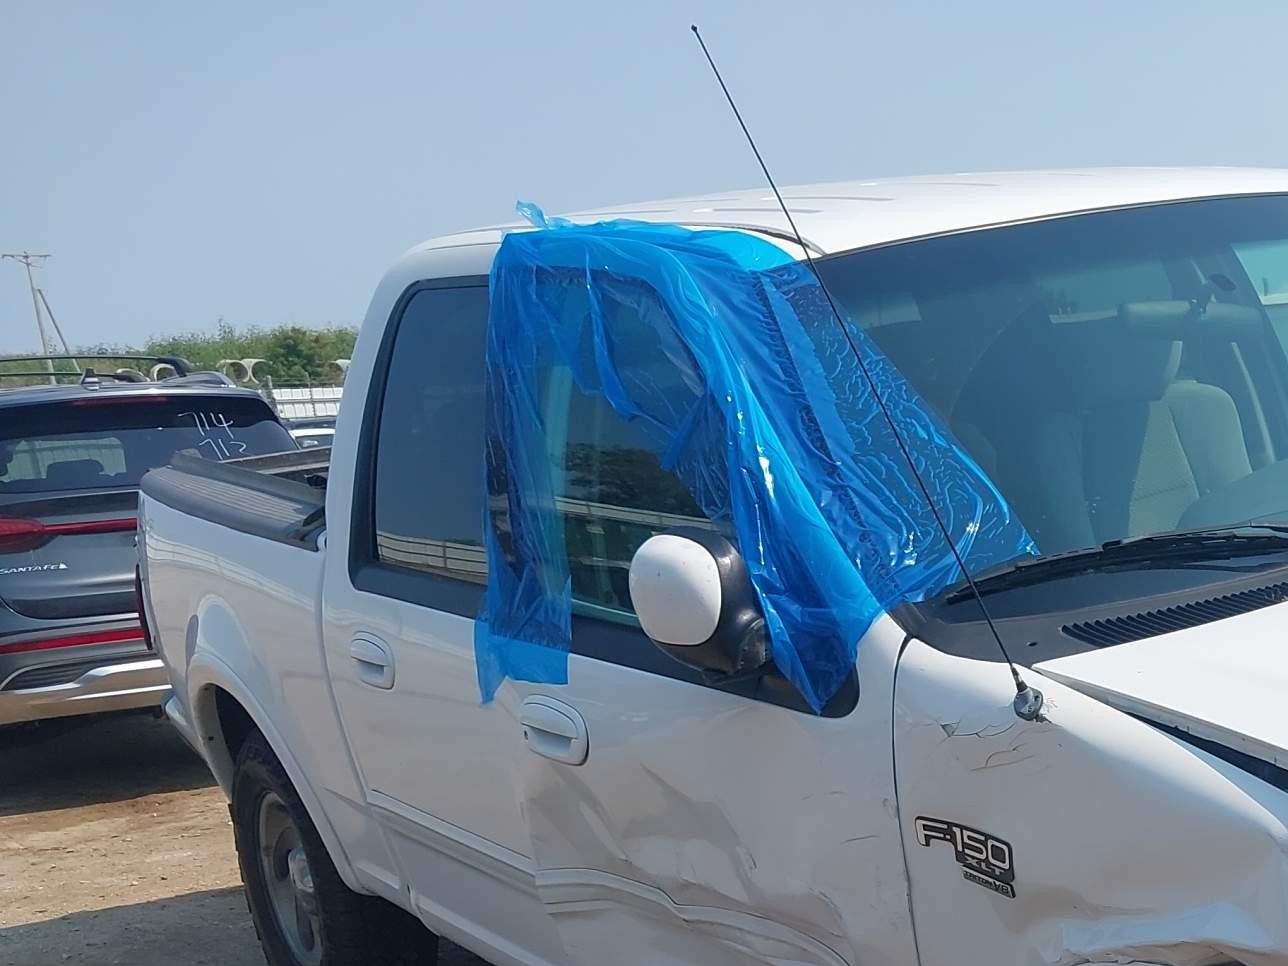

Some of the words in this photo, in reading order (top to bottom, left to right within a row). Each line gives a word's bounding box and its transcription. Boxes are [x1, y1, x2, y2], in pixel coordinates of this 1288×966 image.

[177, 411, 234, 439] 714
[915, 819, 1010, 870] F-150
[965, 856, 1005, 876] XLT
